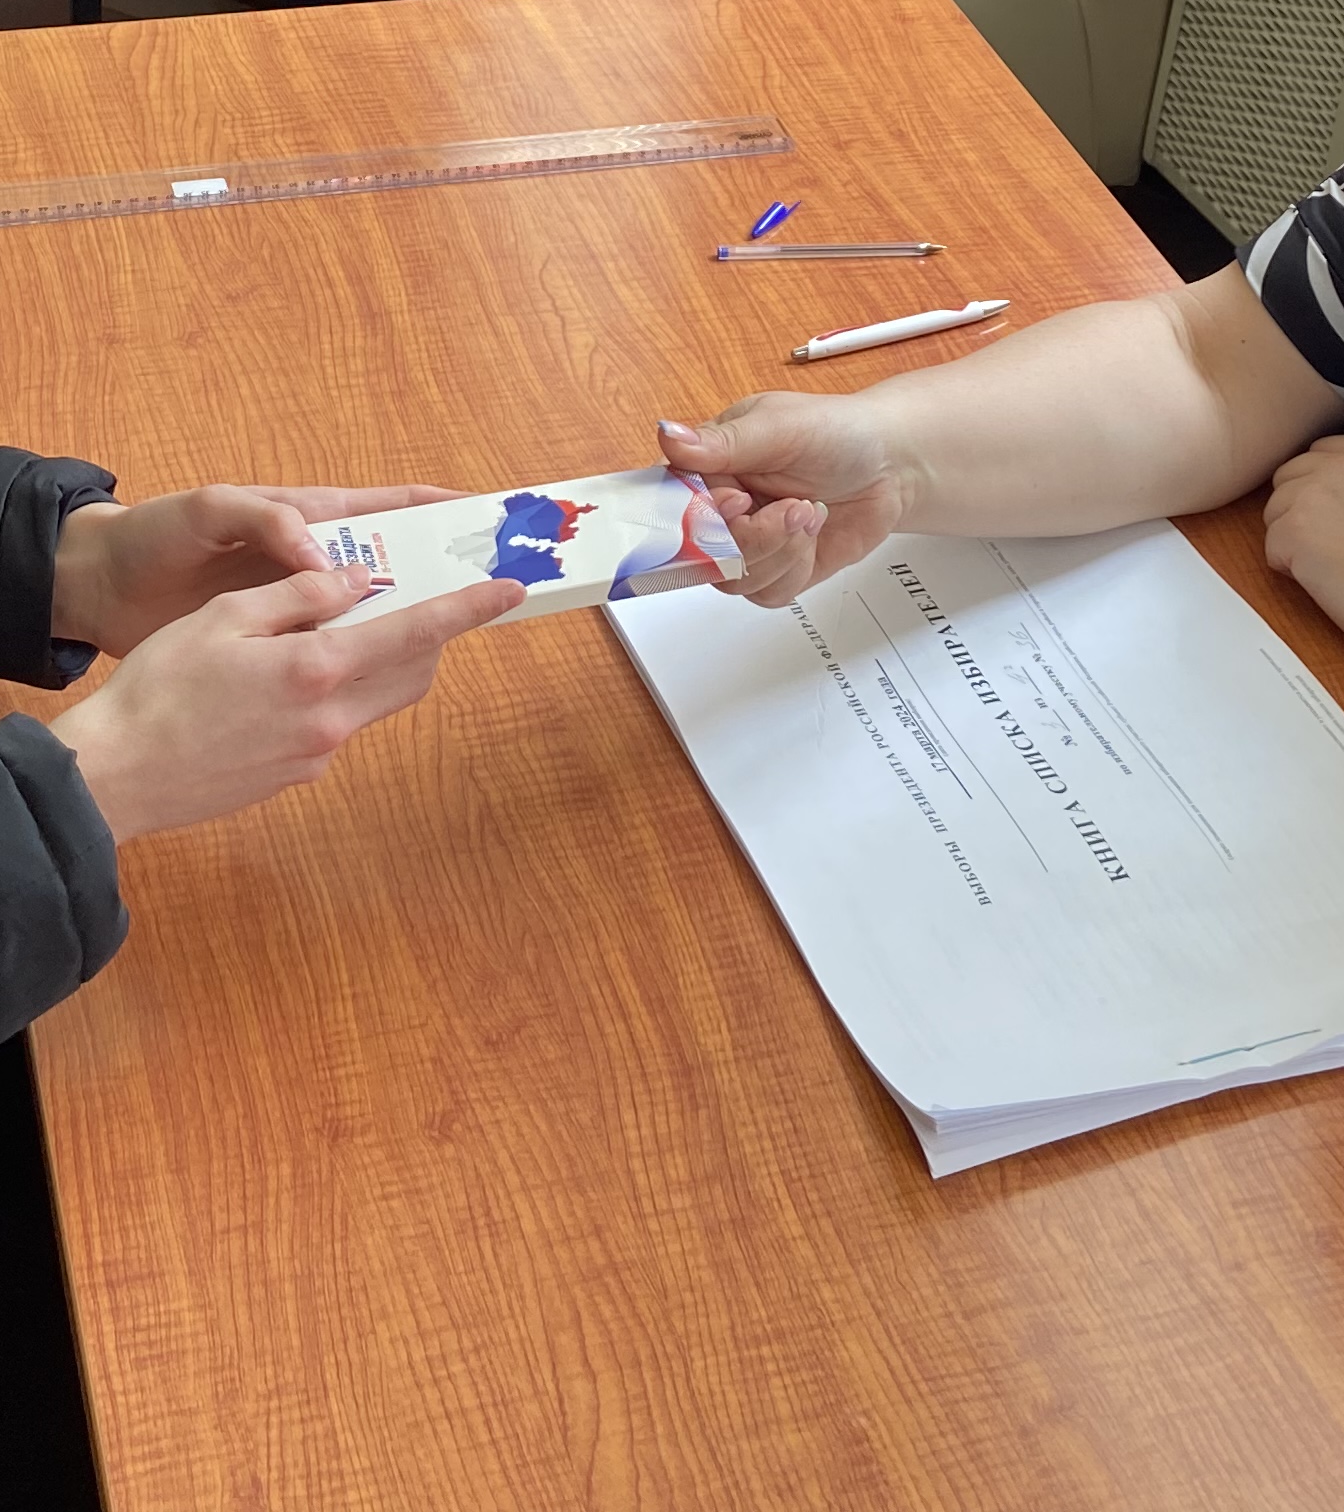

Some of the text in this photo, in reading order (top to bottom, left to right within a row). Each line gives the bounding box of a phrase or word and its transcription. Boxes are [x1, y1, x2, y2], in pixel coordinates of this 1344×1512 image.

[886, 562, 1003, 708] ИЗБИРАТЕЛЕЙ
[826, 661, 886, 751] РОССИЙСКОЙ
[876, 676, 895, 701] года
[1041, 662, 1069, 698] участку
[892, 703, 917, 731] 2024
[908, 728, 939, 763] марта
[1067, 695, 1123, 764] избирательному
[994, 708, 1069, 795] СПИСКА
[1120, 762, 1133, 777] по
[884, 751, 949, 834] ПРЕЗИДЕНТА
[943, 840, 992, 906] ВЫБОРЫ
[1064, 799, 1131, 884] КНИГА
